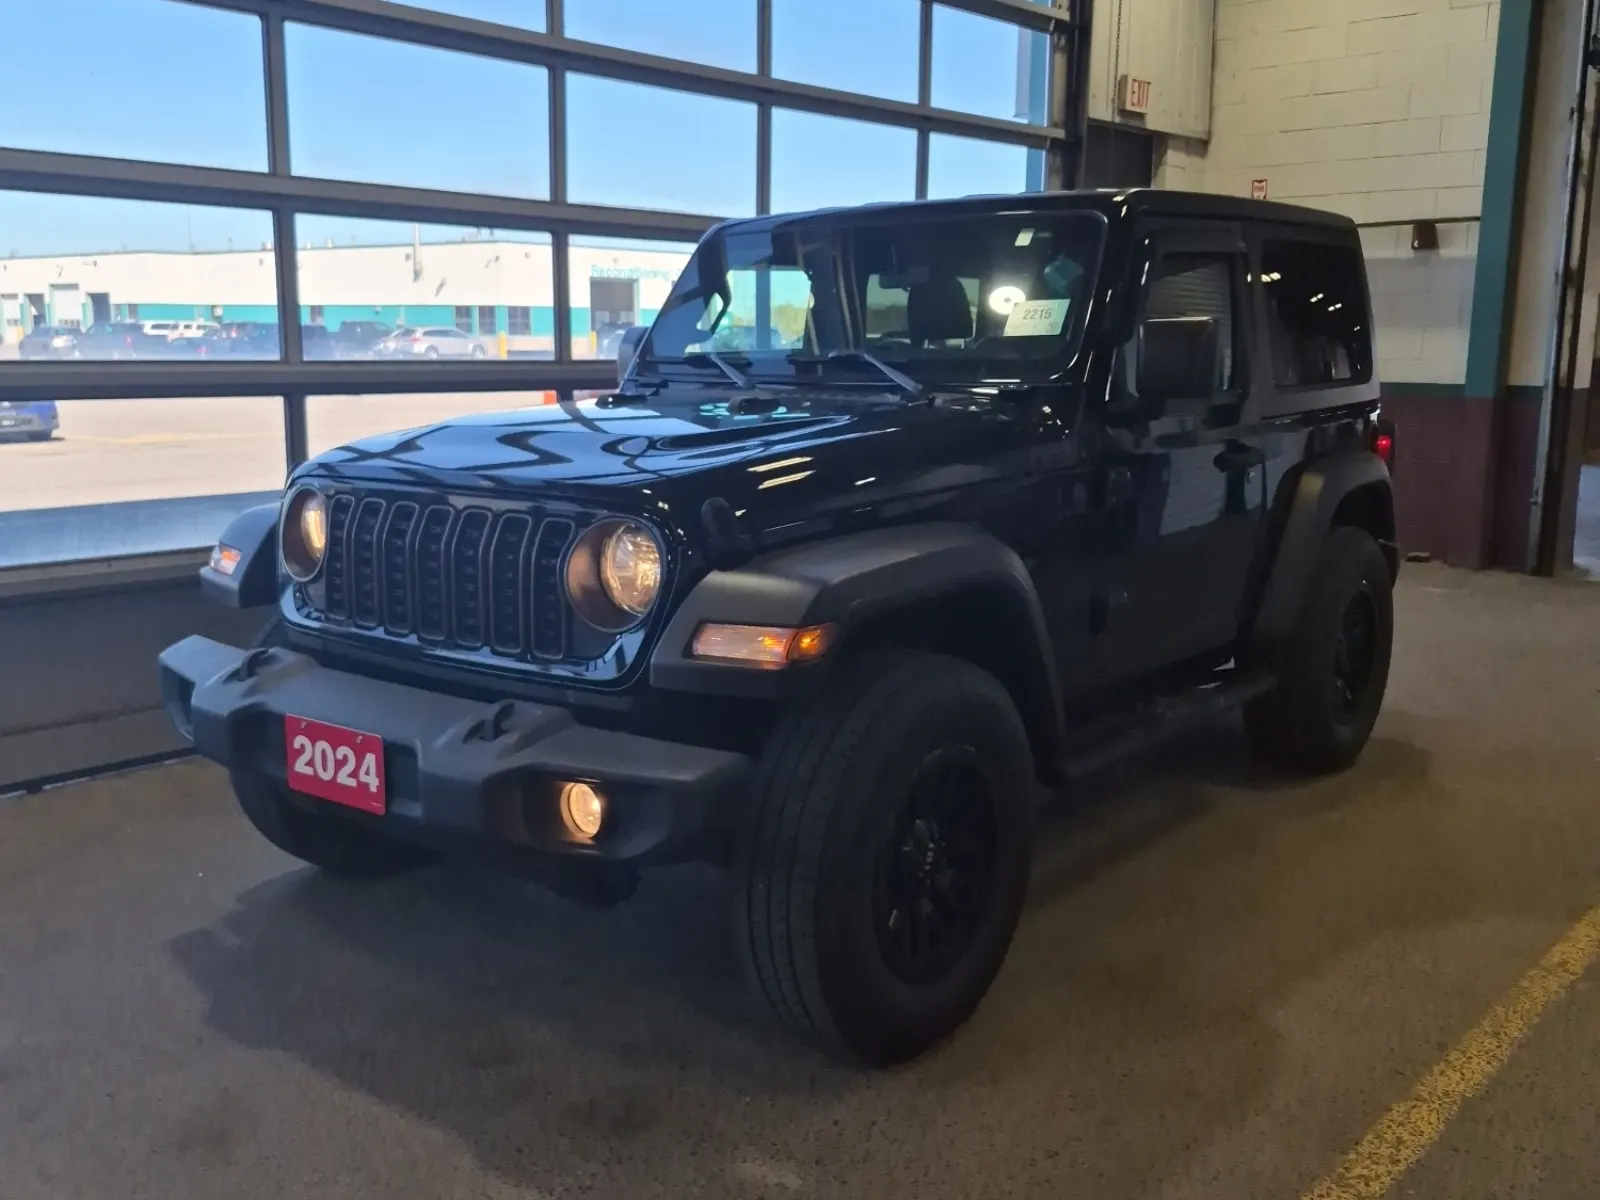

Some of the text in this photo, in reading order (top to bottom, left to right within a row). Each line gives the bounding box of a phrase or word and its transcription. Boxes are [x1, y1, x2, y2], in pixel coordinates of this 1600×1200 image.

[1131, 78, 1151, 108] EXIT
[1022, 308, 1053, 320] 2215
[293, 734, 380, 792] 2024
